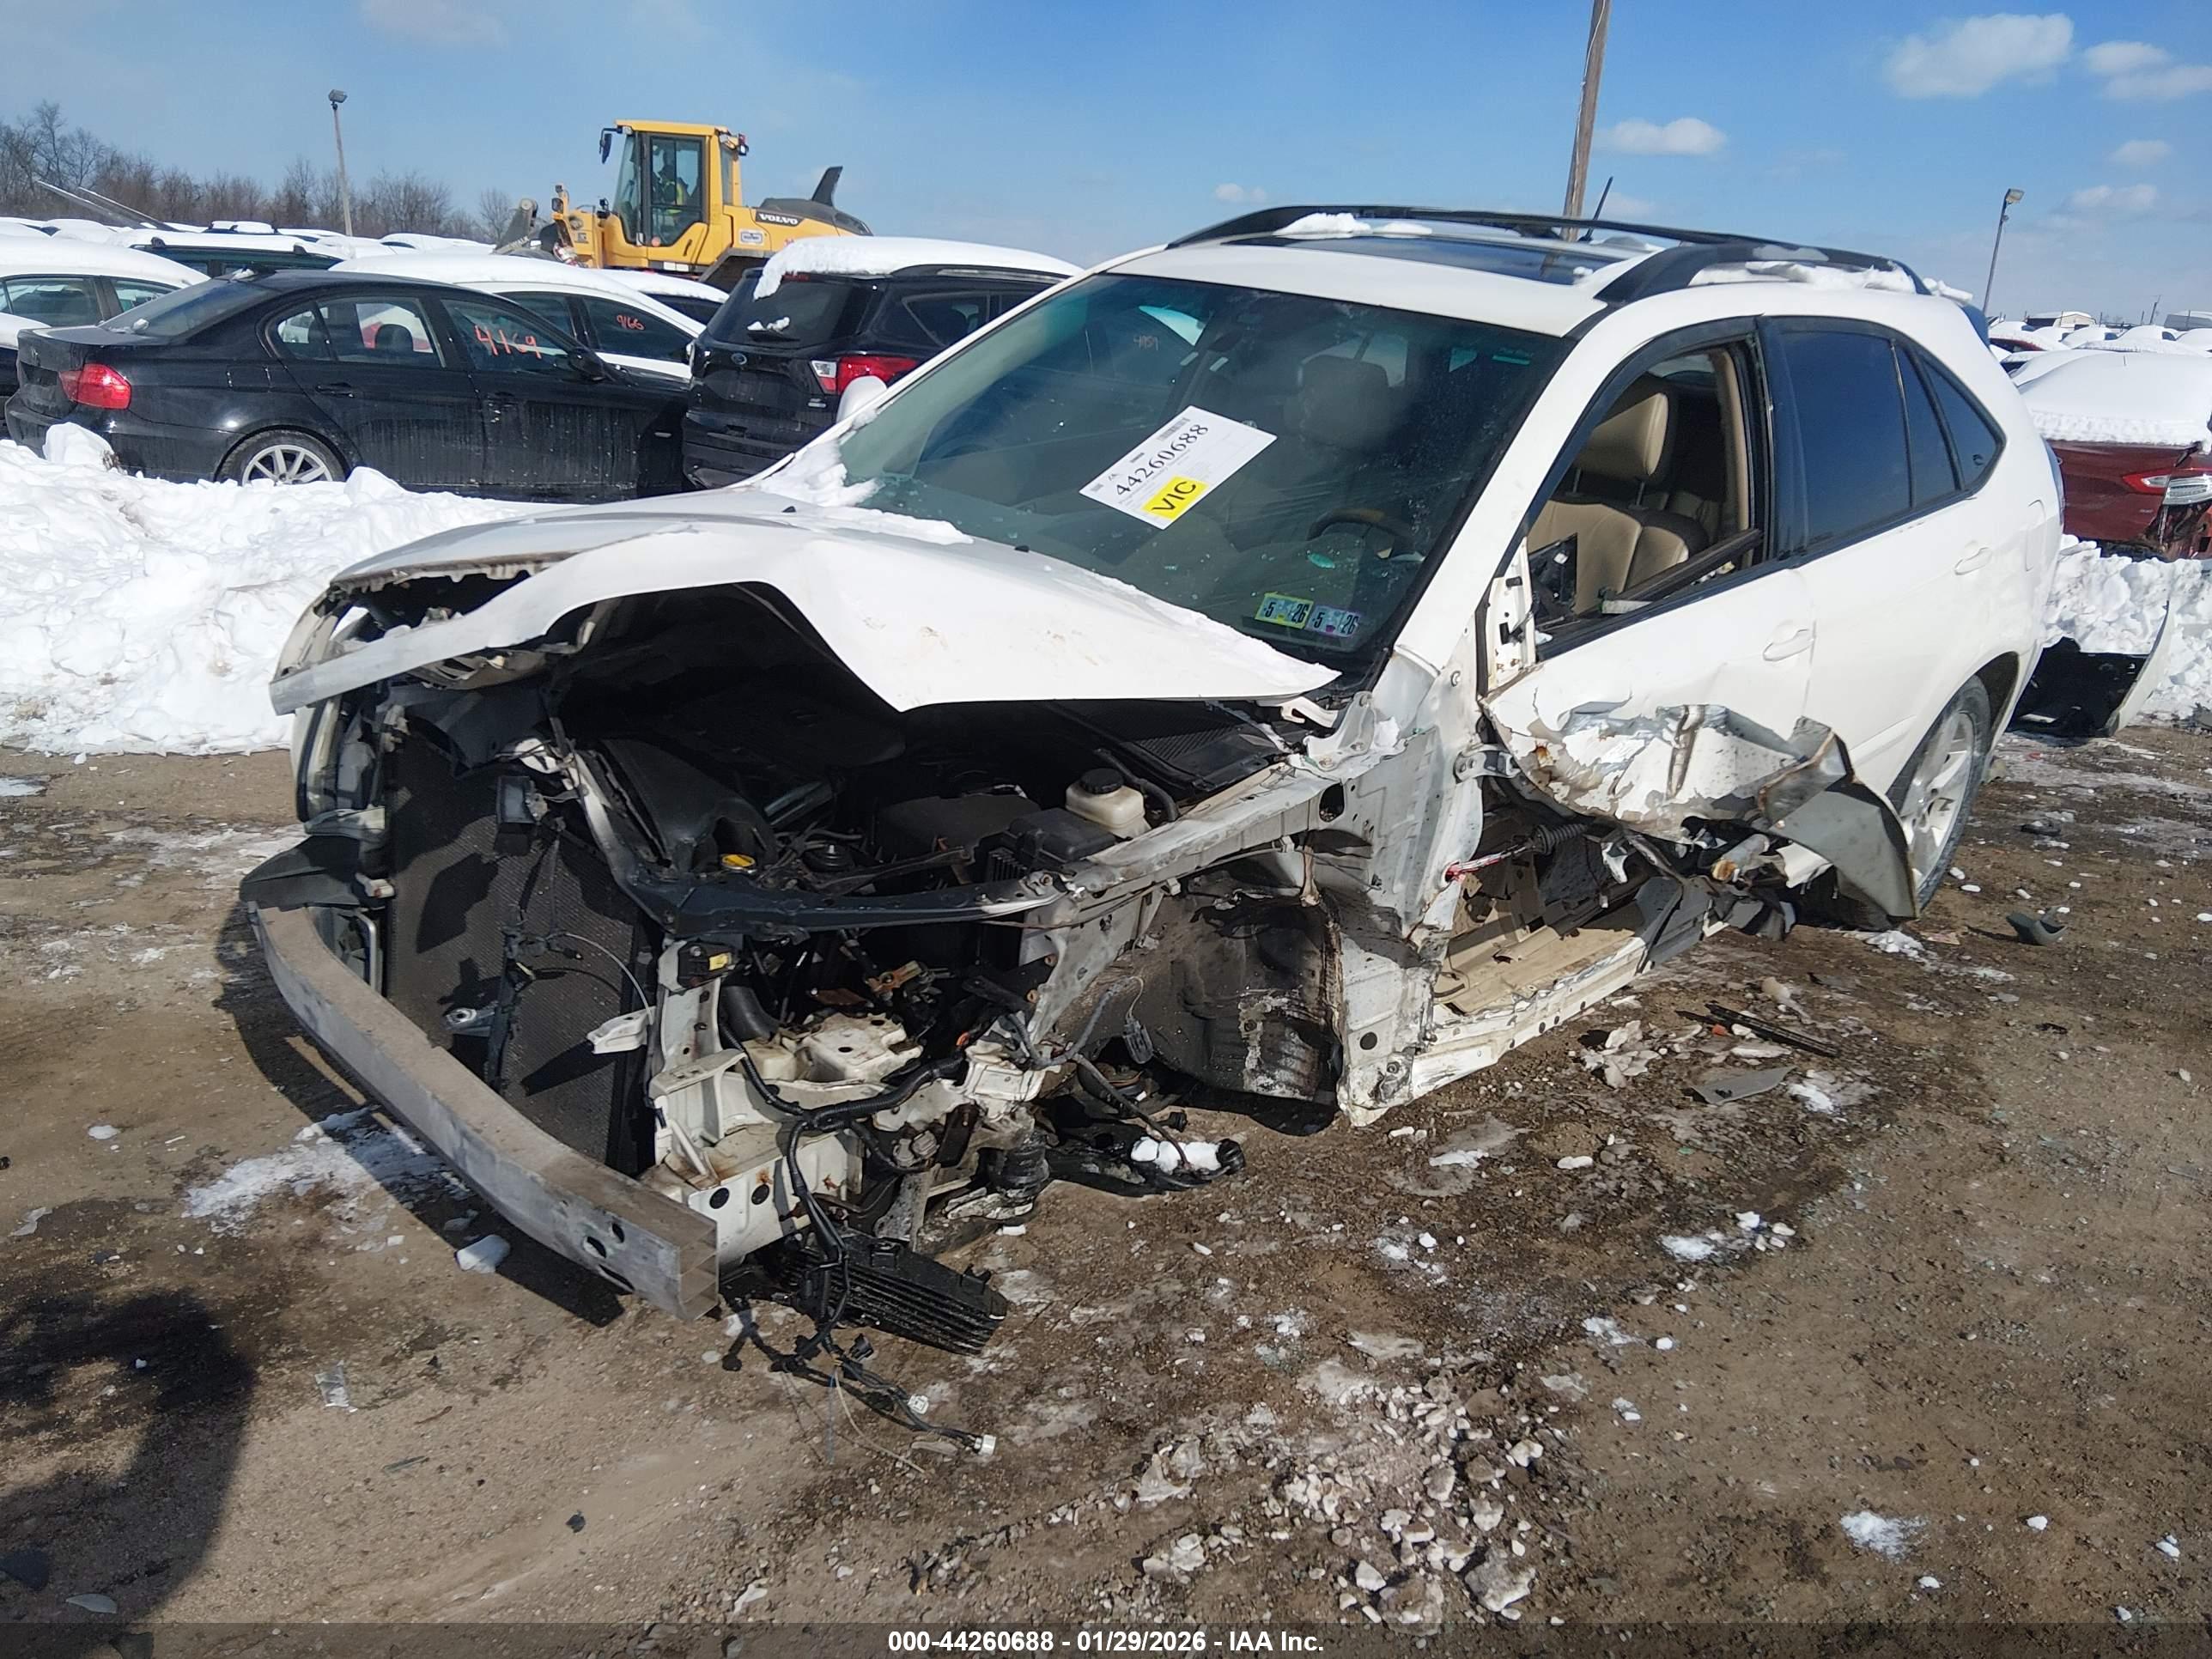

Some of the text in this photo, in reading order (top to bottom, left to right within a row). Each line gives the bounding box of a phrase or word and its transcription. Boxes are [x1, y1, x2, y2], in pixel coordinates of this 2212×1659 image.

[759, 213, 799, 225] VOLVO
[1116, 424, 1209, 496] 44260688
[1152, 481, 1197, 512] VIC
[1291, 604, 1310, 623] 26
[1341, 615, 1359, 635] 26
